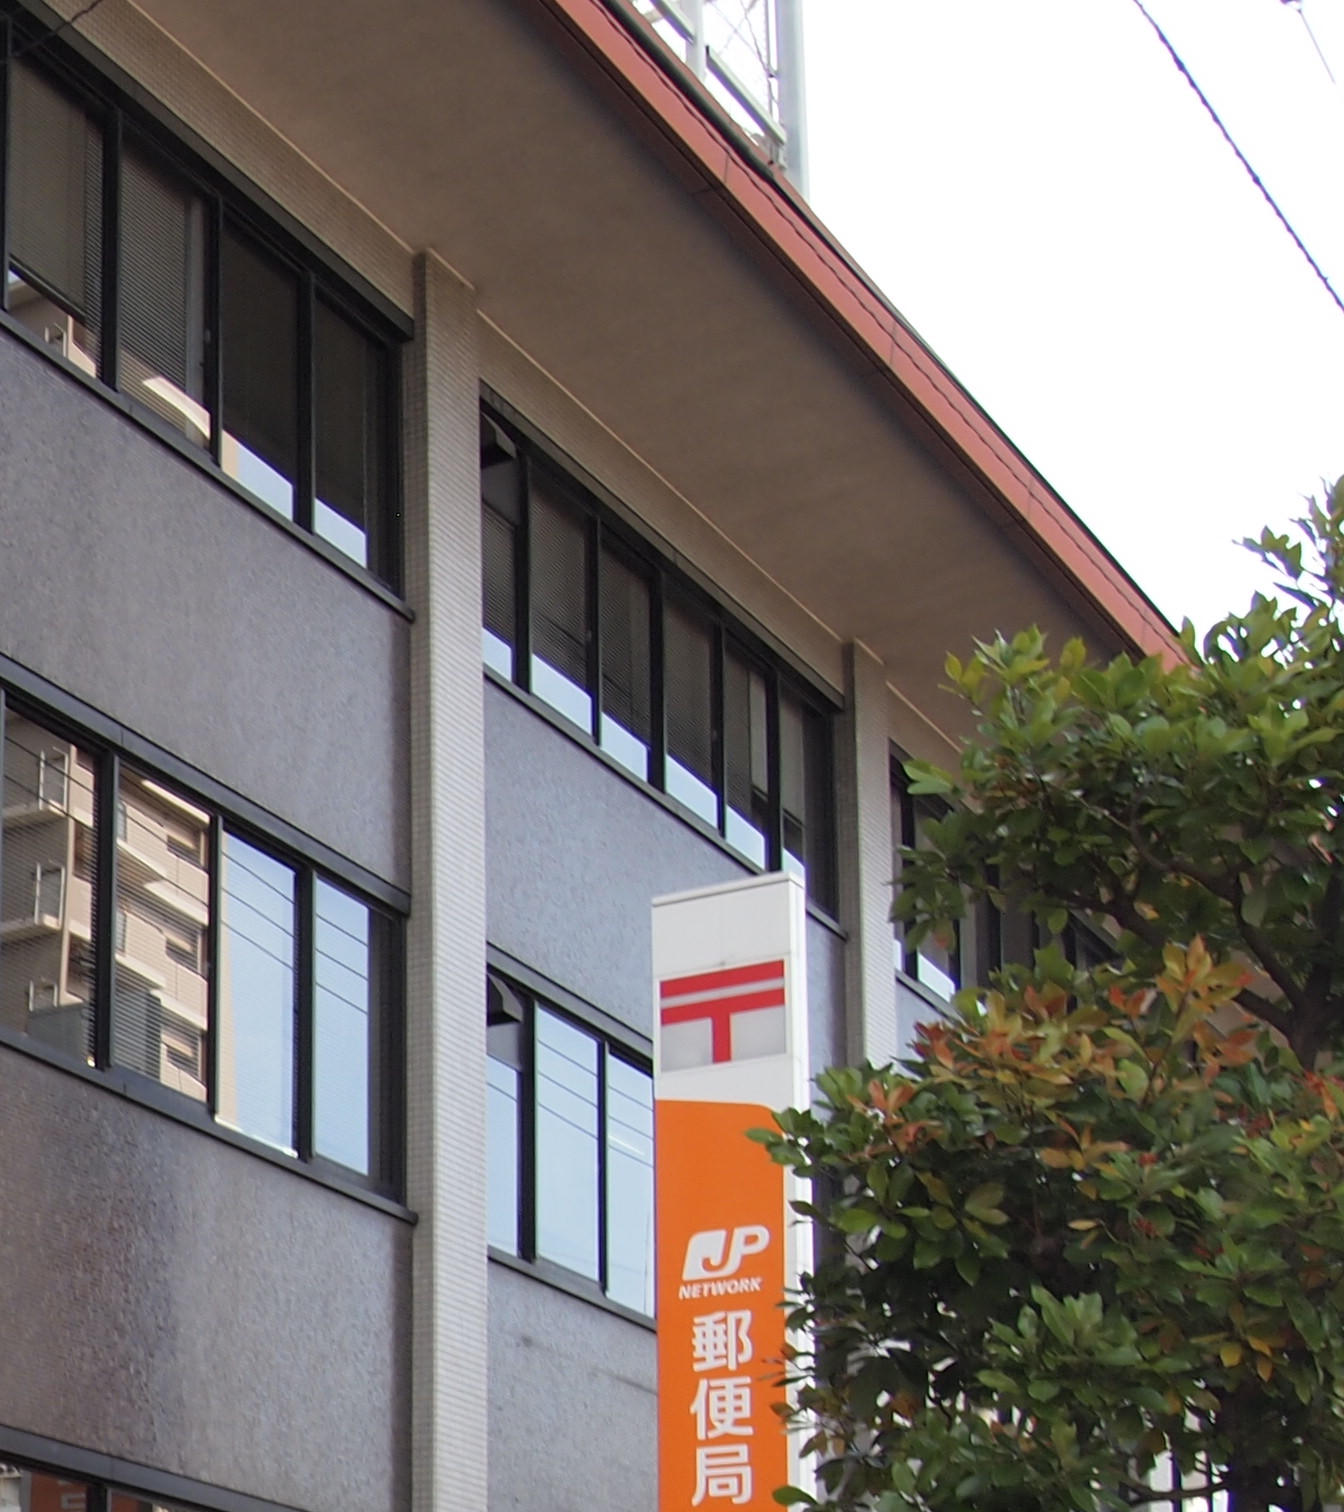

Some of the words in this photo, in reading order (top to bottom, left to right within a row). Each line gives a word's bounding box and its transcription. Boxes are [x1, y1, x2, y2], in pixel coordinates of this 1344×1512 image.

[677, 1276, 764, 1301] NETWORK
[688, 1308, 754, 1508] 郵便局
